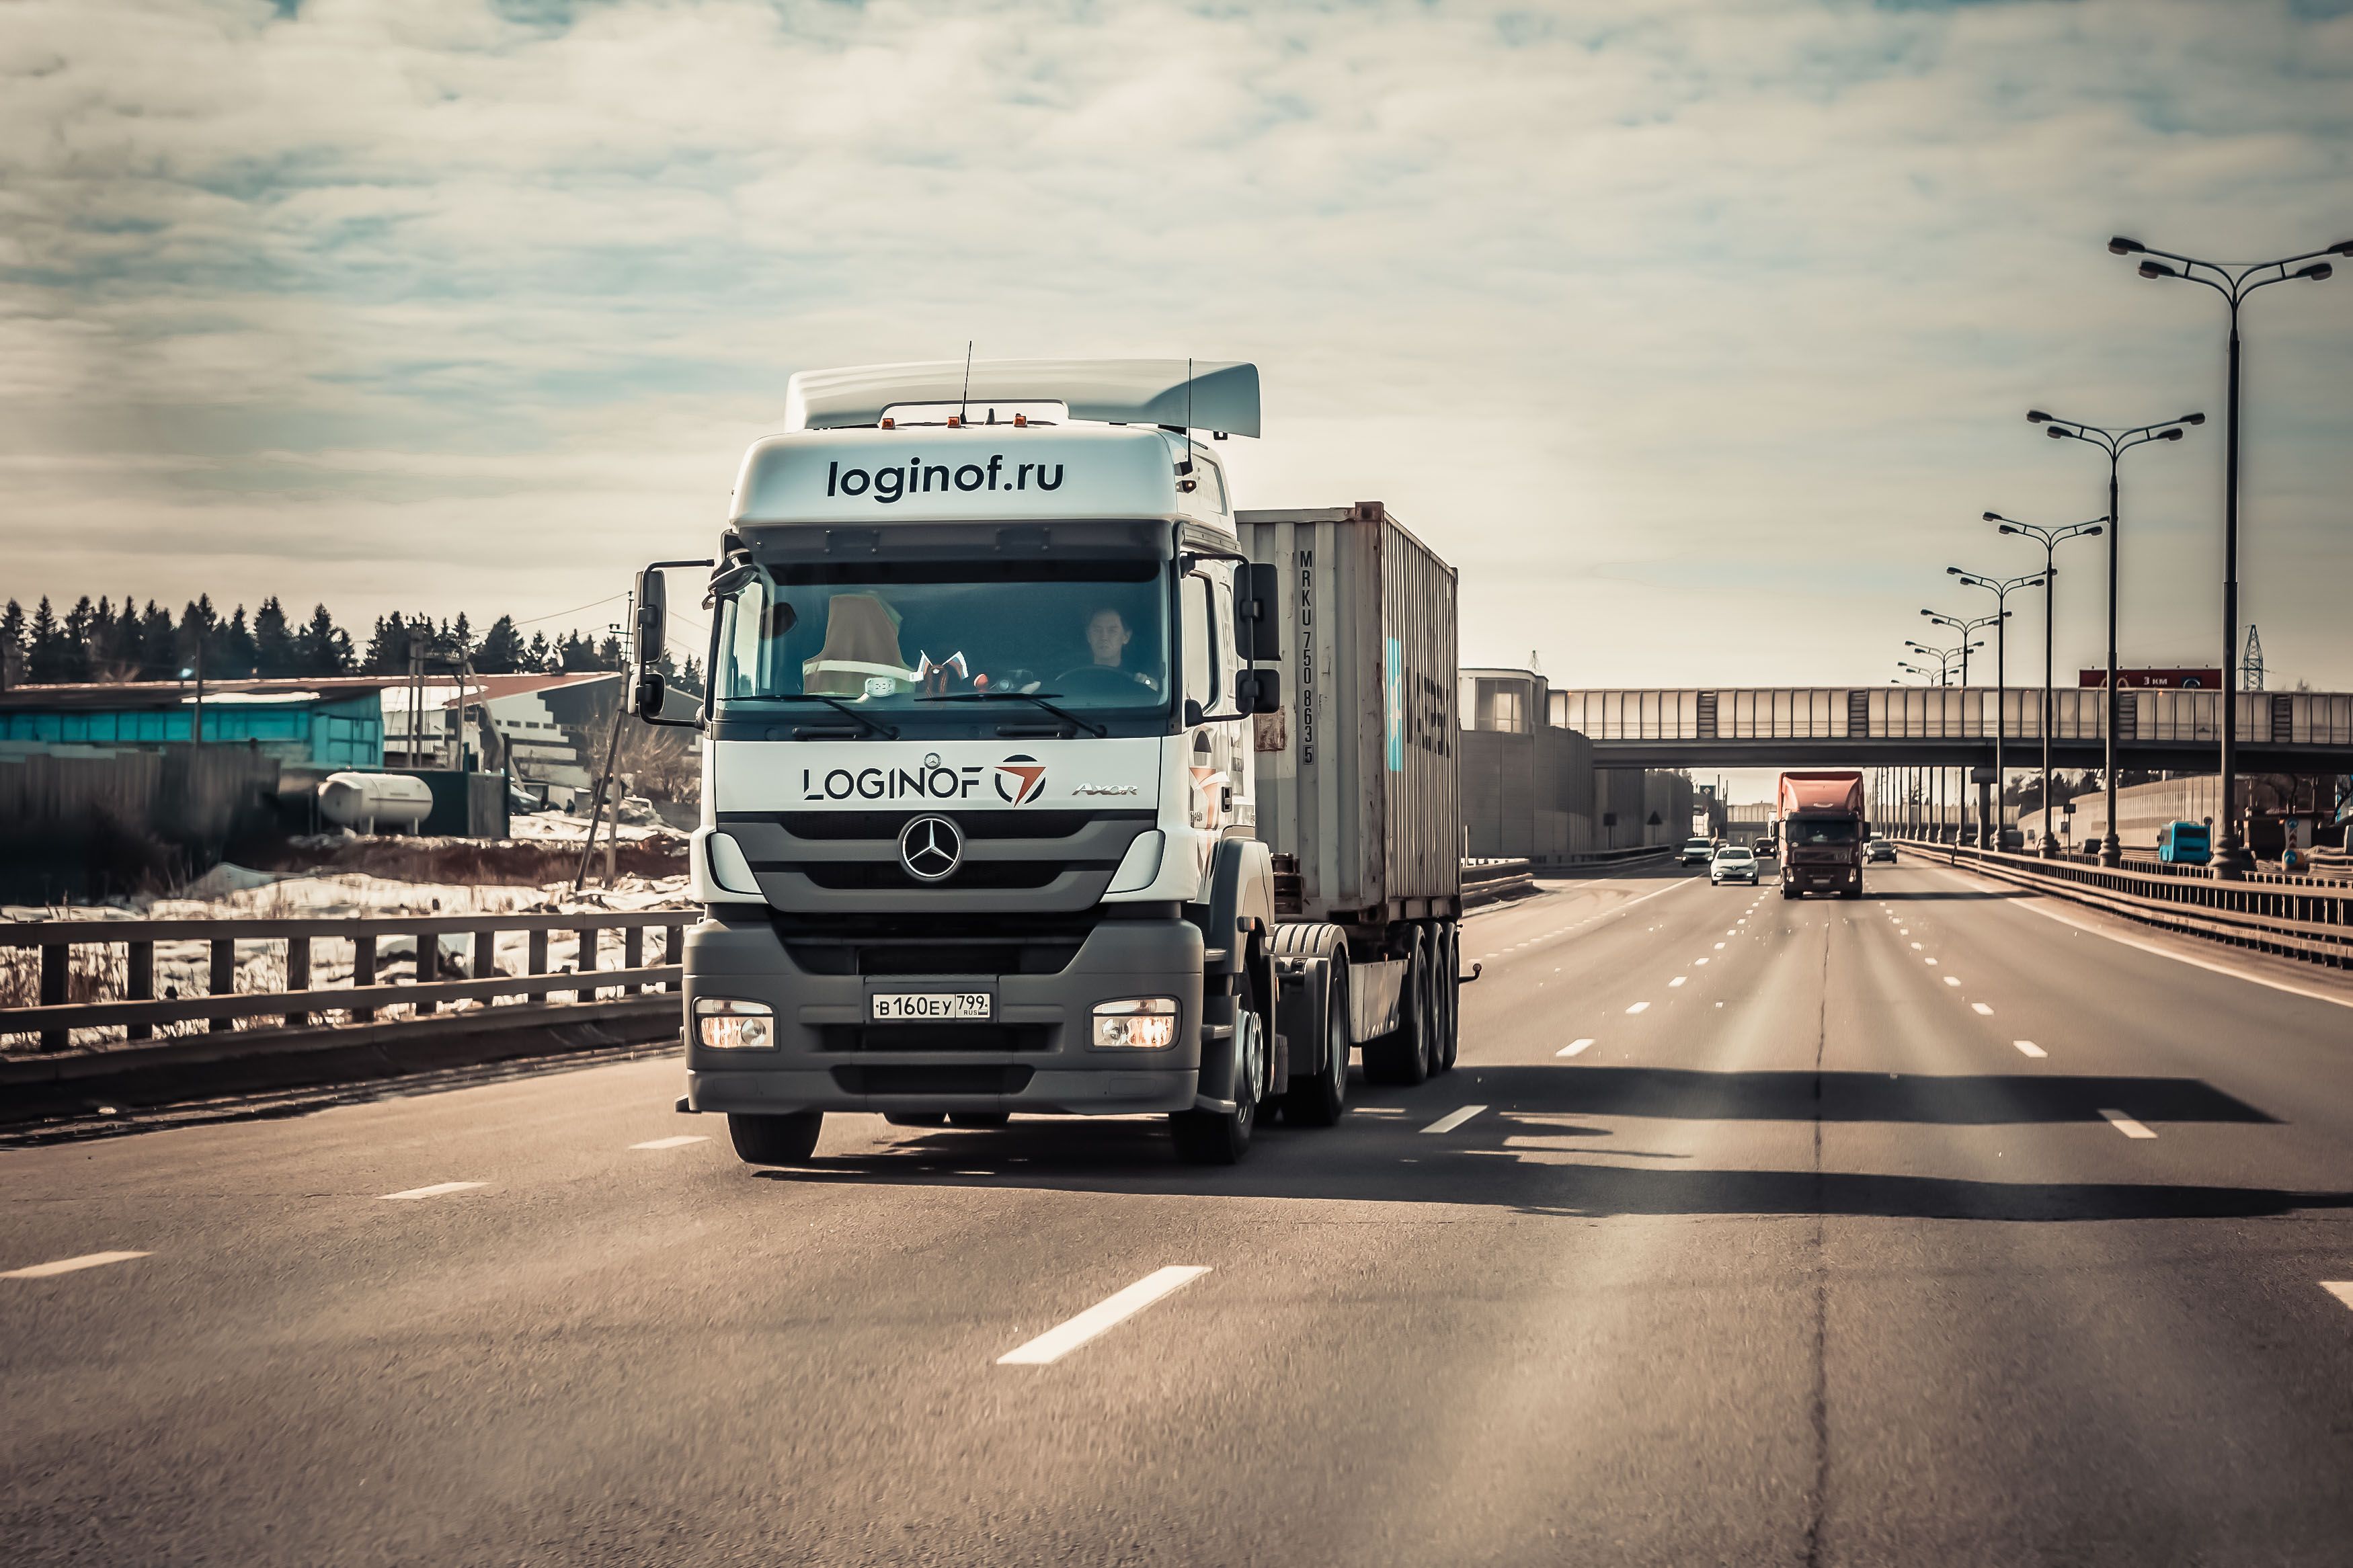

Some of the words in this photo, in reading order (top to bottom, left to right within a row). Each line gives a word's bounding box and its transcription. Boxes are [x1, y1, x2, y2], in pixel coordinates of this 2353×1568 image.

[827, 454, 1064, 504] loginof.ru
[1300, 550, 1312, 626] MRKU
[1303, 631, 1312, 684] 750
[2143, 676, 2150, 686] 3
[803, 766, 984, 800] LOGINOF
[957, 995, 985, 1010] 799
